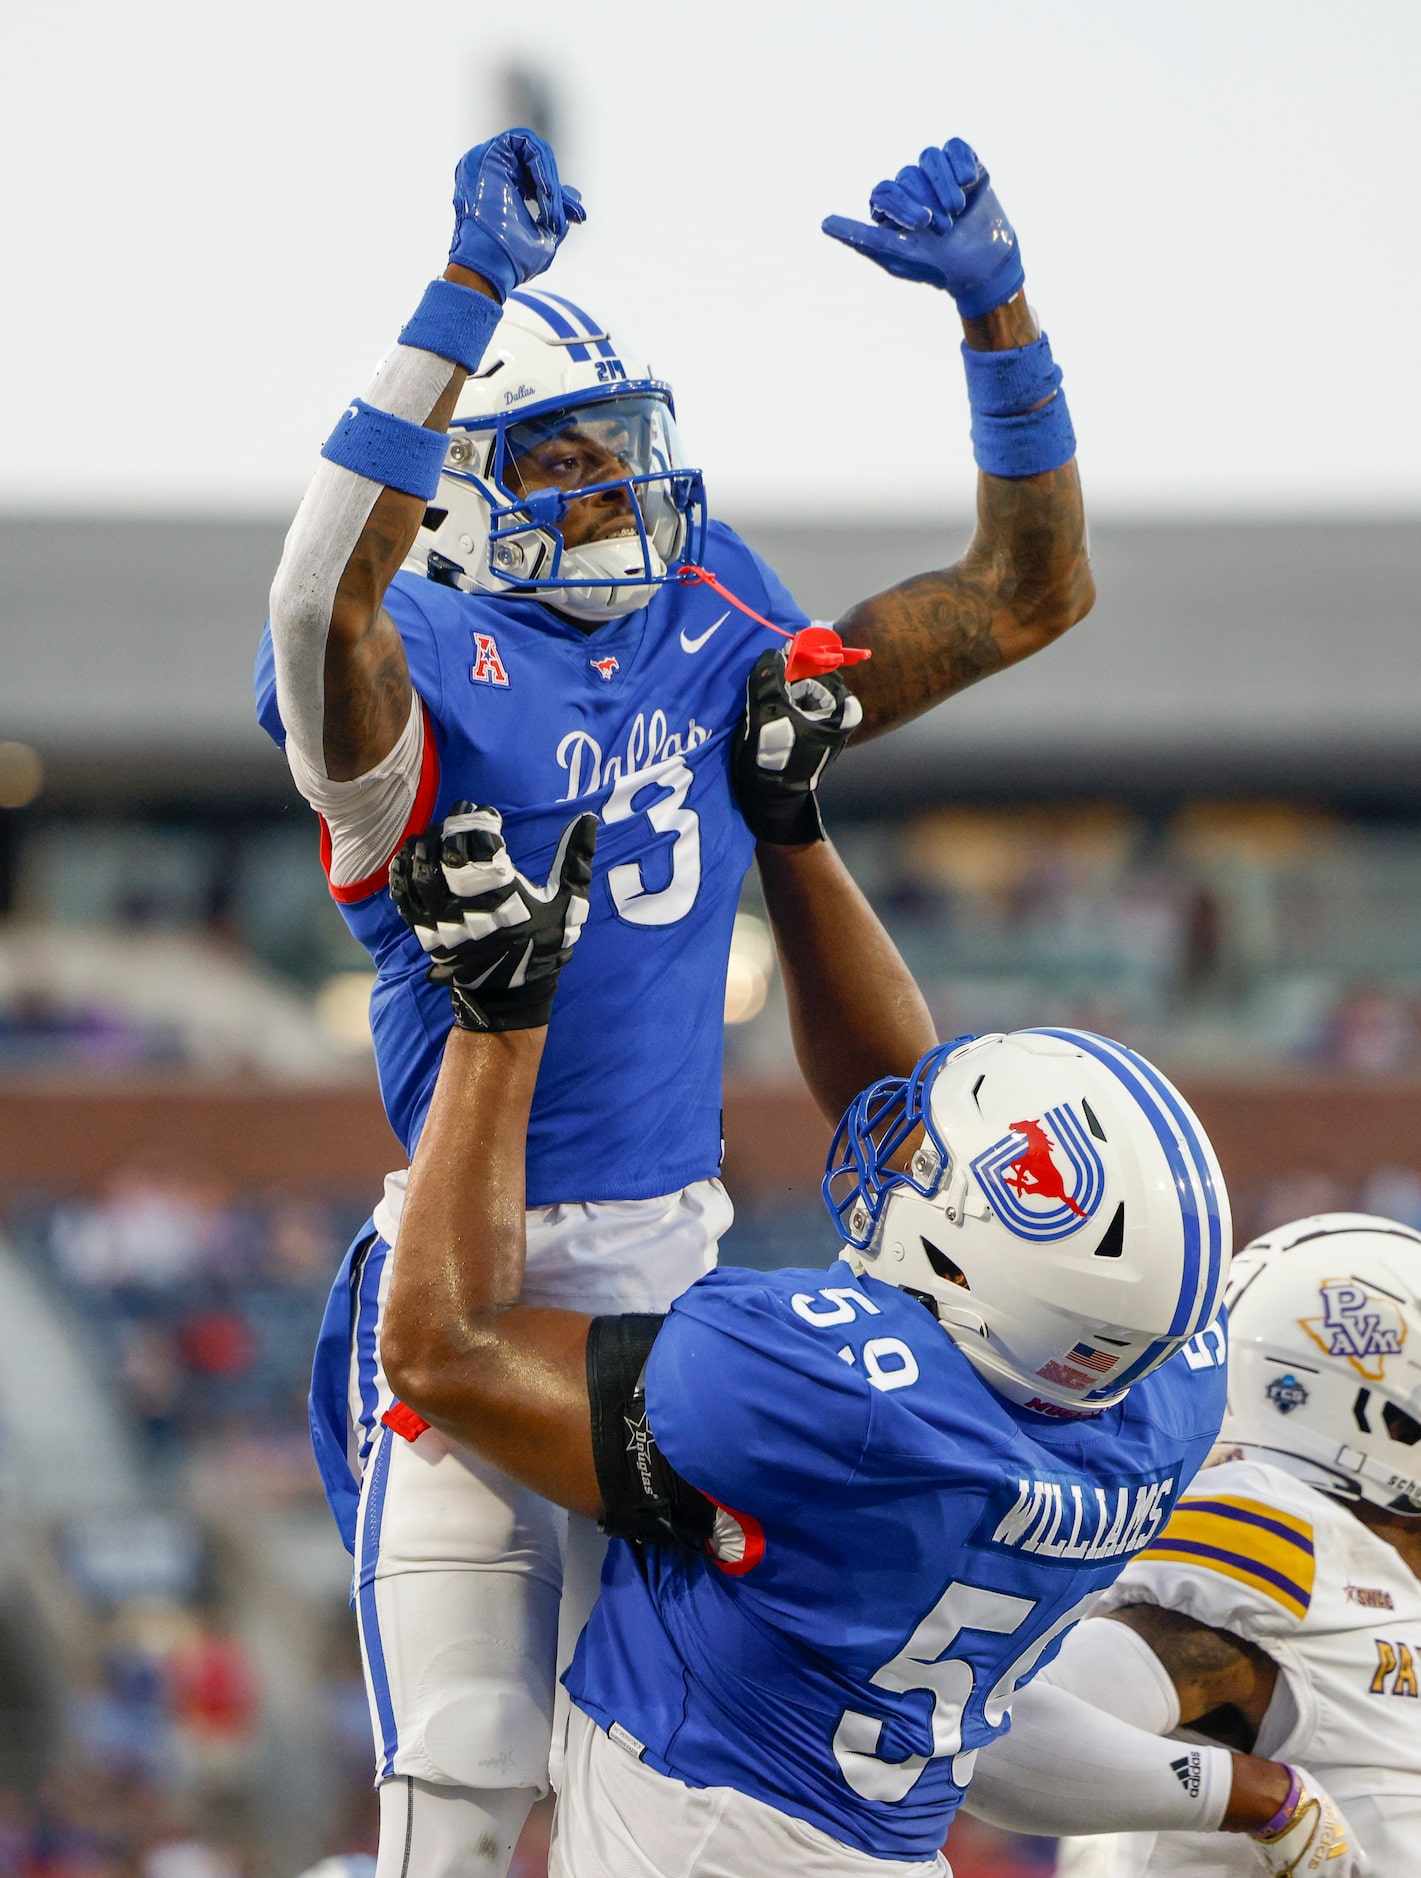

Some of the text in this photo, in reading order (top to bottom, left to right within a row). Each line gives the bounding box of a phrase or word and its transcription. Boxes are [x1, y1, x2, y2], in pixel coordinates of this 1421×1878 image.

[504, 384, 536, 406] Dallas
[472, 632, 509, 687] A
[601, 755, 700, 927] 3
[791, 1287, 920, 1393] 59
[635, 1430, 655, 1496] Douglas
[992, 1478, 1174, 1561] WILLIAMS
[1370, 1639, 1421, 1698] PA
[1188, 1751, 1201, 1799] adidas
